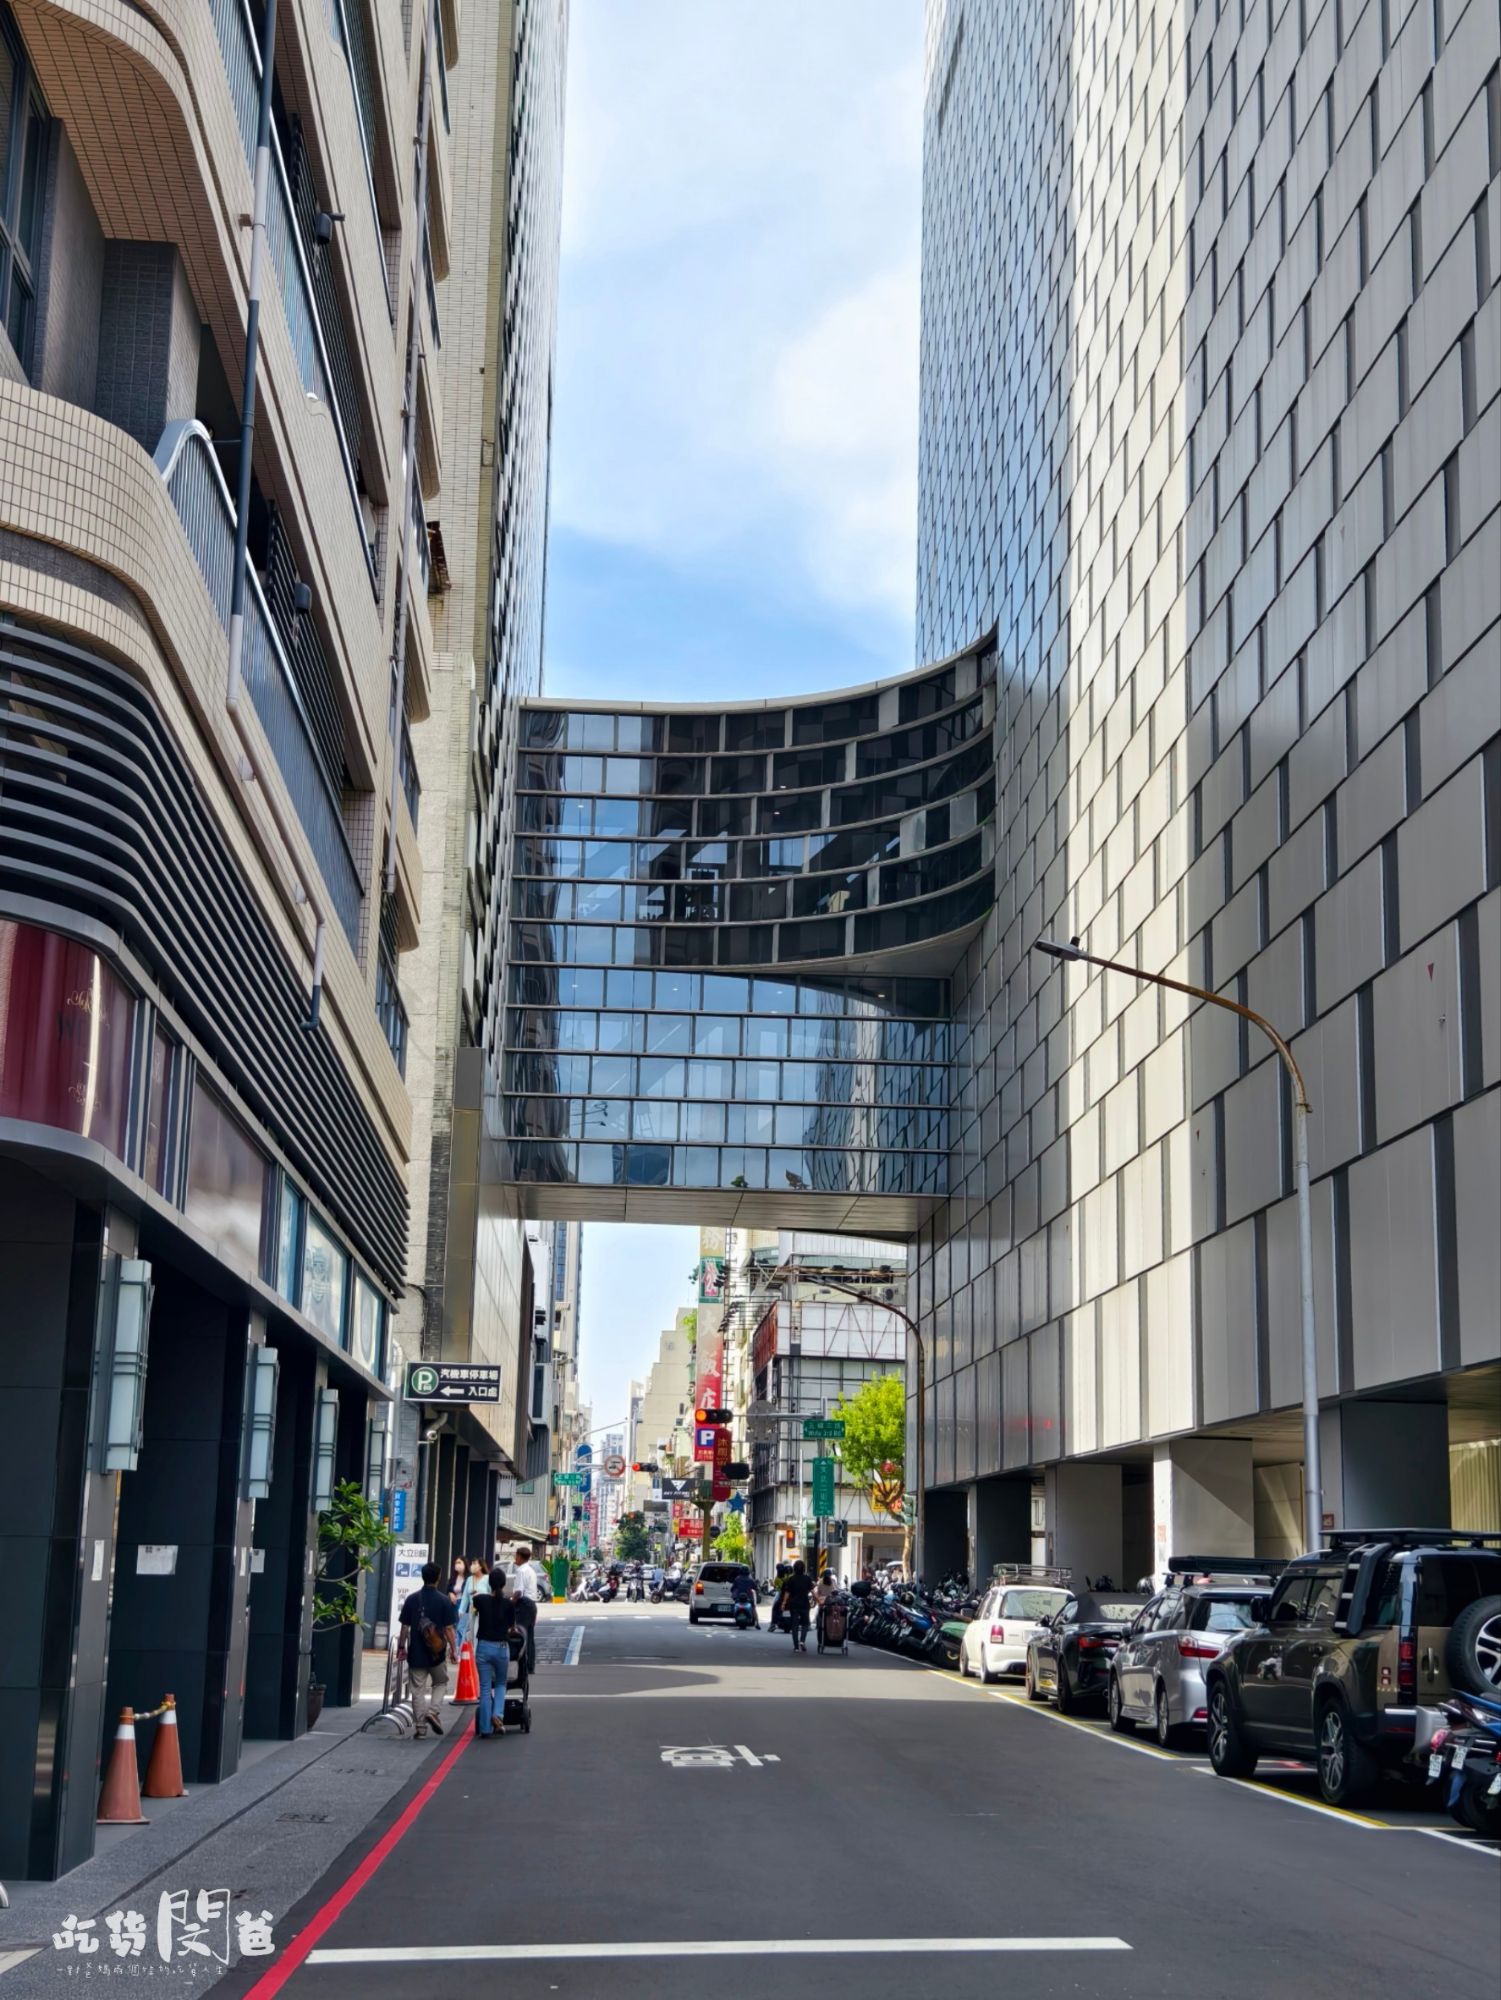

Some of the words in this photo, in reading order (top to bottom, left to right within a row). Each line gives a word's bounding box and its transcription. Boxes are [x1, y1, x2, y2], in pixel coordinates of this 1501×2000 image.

[440, 1368, 499, 1380] 汽機車停車場
[700, 1429, 715, 1446] P
